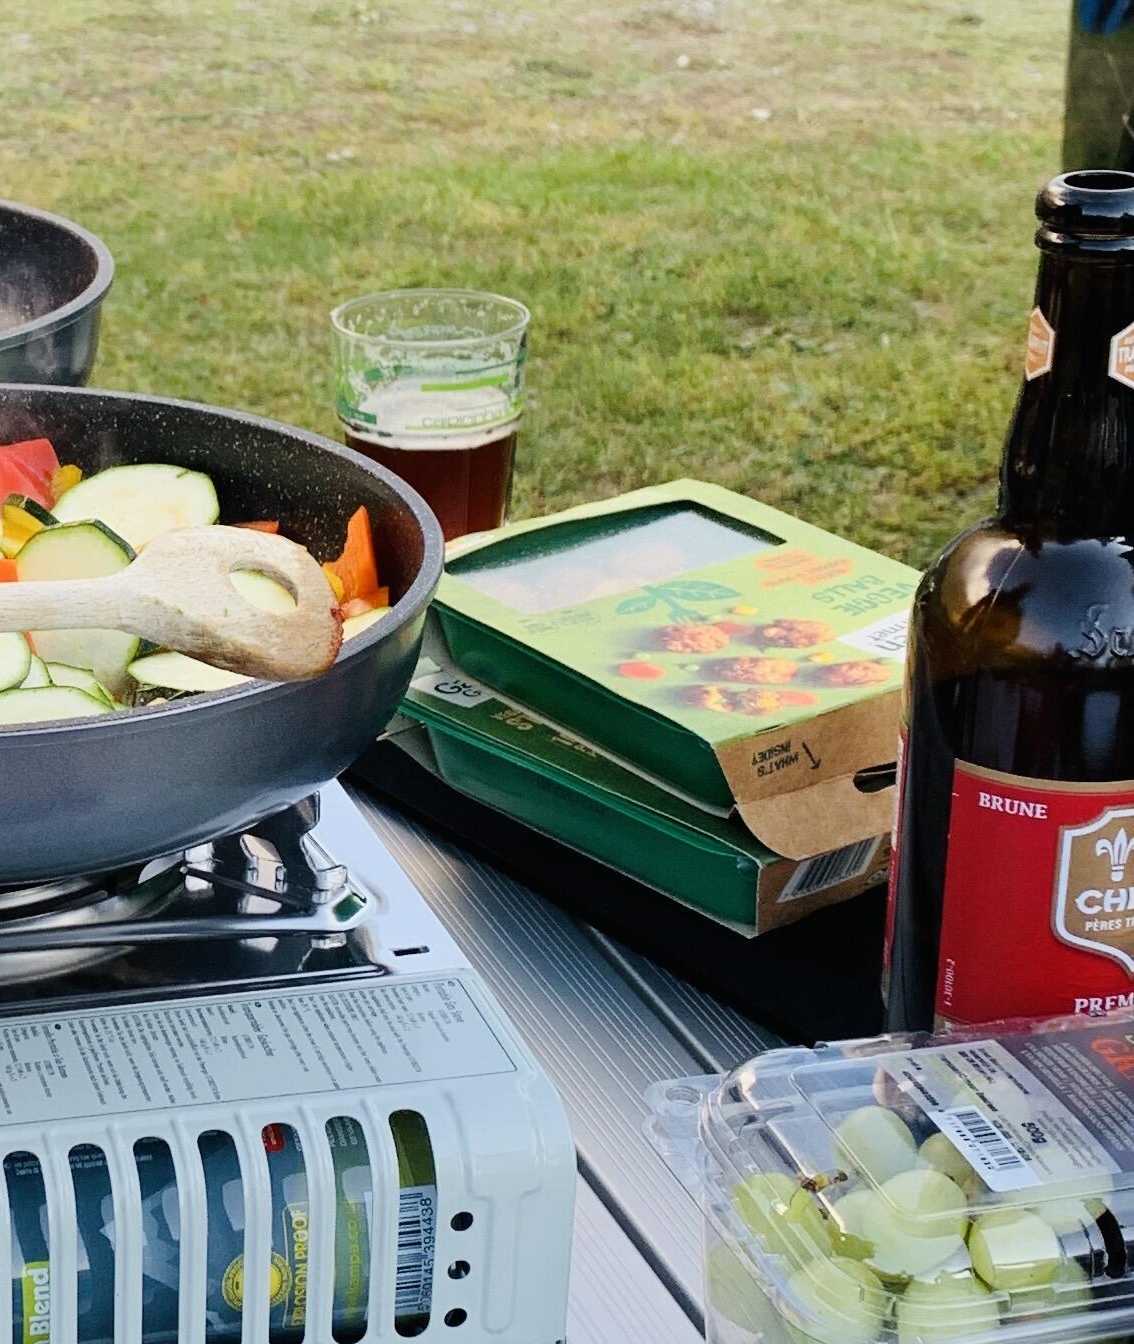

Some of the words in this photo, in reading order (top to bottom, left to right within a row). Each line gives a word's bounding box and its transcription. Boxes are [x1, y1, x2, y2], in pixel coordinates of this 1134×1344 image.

[979, 792, 1048, 819] BRUNE
[1084, 918, 1123, 933] PÈRES
[290, 1209, 309, 1260] PROOF
[28, 1268, 50, 1337] Blend
[290, 1263, 308, 1327] EXPLOSION
